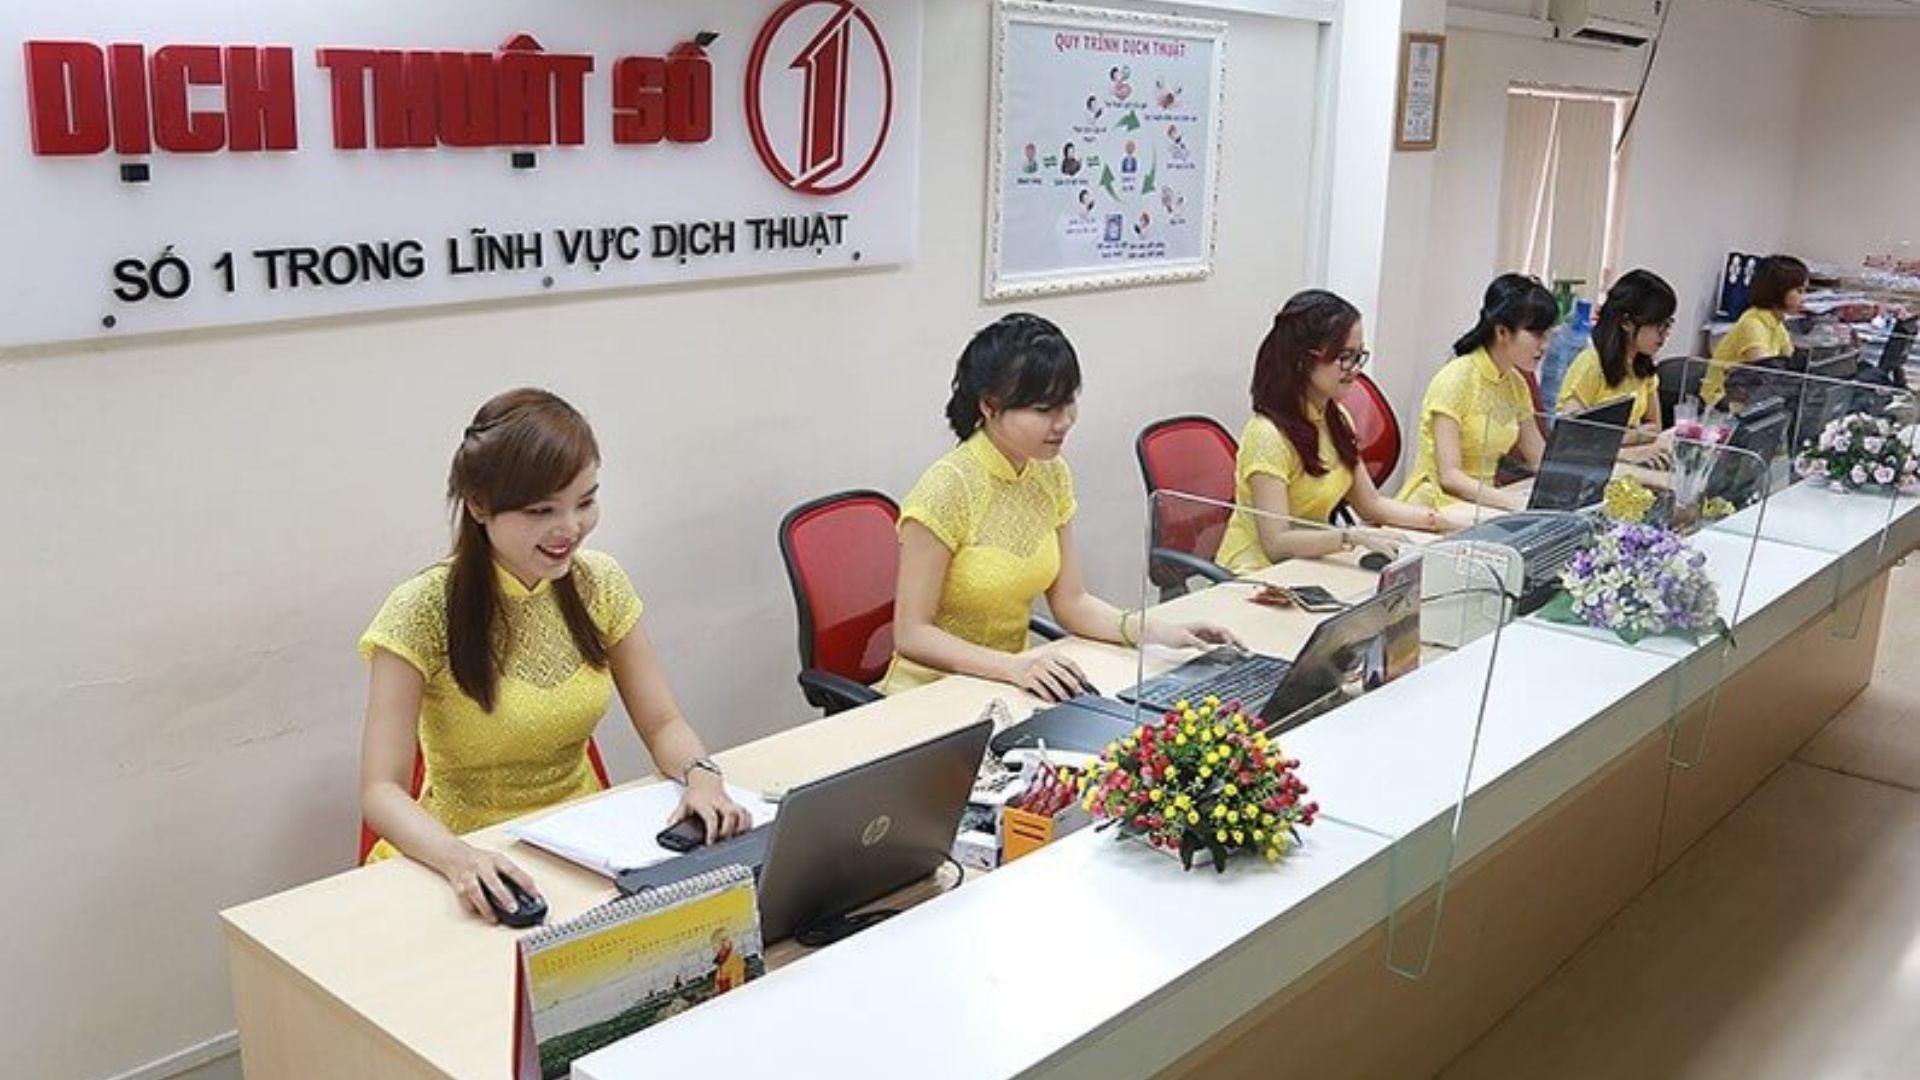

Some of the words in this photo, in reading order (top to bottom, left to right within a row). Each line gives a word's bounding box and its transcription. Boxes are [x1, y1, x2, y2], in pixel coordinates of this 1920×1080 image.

[1055, 32, 1079, 52] QUY
[23, 40, 298, 183] DỊCH
[315, 33, 595, 170] THUẬT
[612, 31, 715, 146] SỐ
[113, 244, 191, 302] SỐ
[213, 251, 235, 293] 1
[253, 240, 426, 289] TRONG
[446, 227, 543, 275] LĨNH
[555, 225, 641, 272] VỰC
[651, 220, 736, 265] DỊCH
[744, 211, 849, 255] THUẬT
